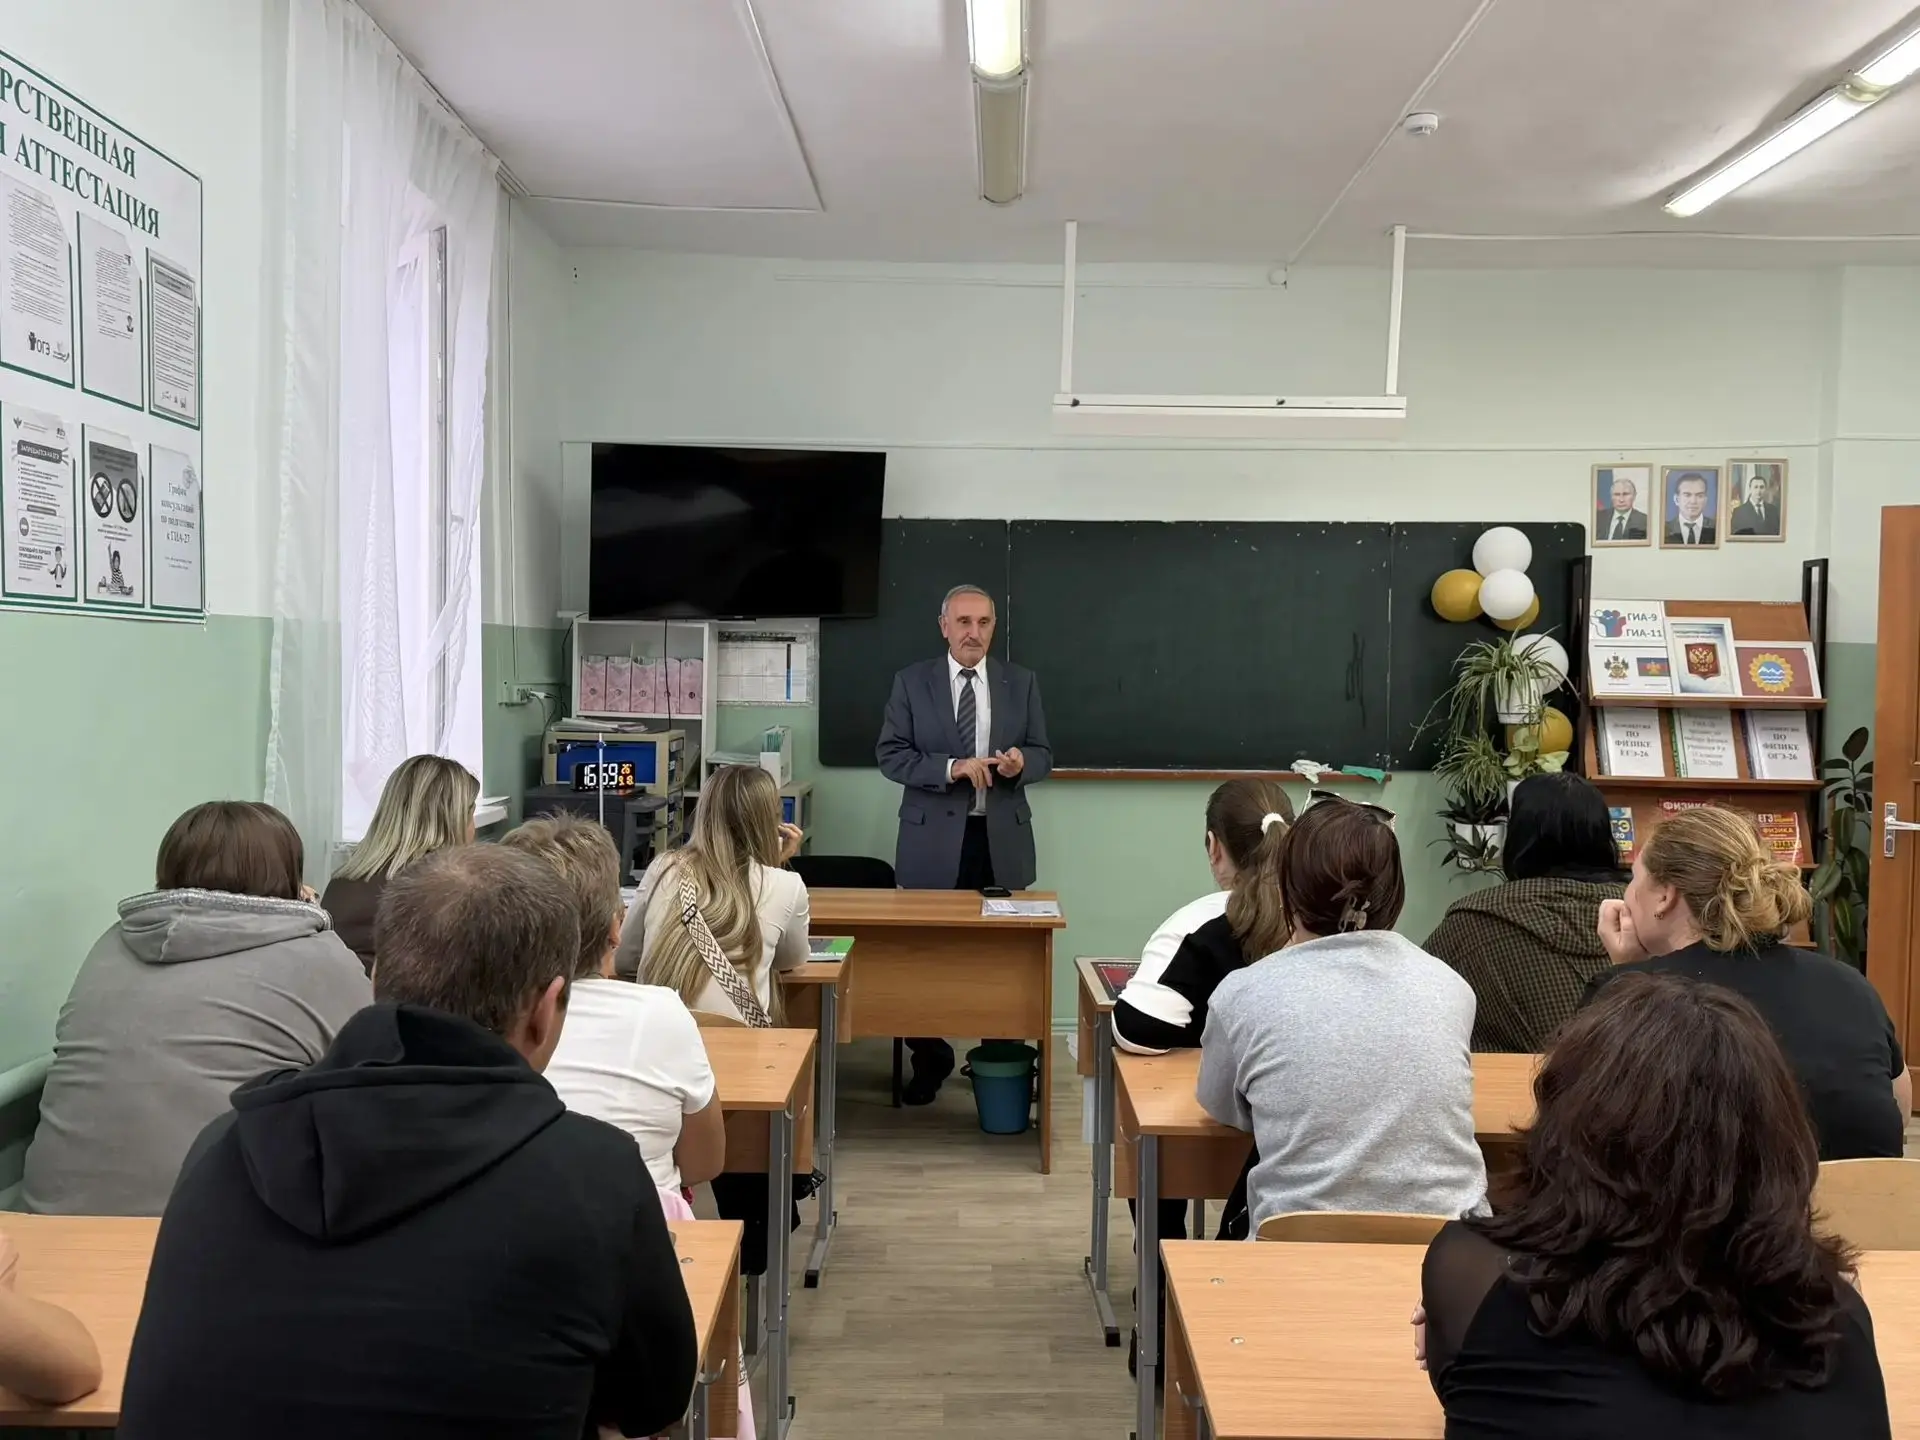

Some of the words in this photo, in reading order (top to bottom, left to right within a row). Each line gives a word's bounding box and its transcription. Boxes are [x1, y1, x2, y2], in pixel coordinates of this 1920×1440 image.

[0, 67, 137, 180] РСТВЕННАЯ
[14, 133, 160, 239] АТТЕСТАЦИЯ
[1627, 613, 1658, 622] ГИА-9
[1626, 629, 1663, 638] ГИА-11
[1614, 740, 1652, 748] ФИЗИКЕ
[1762, 742, 1800, 751] ФИЗИКЕ
[1758, 813, 1774, 823] ЕГЭ
[1610, 819, 1631, 833] ГЭ
